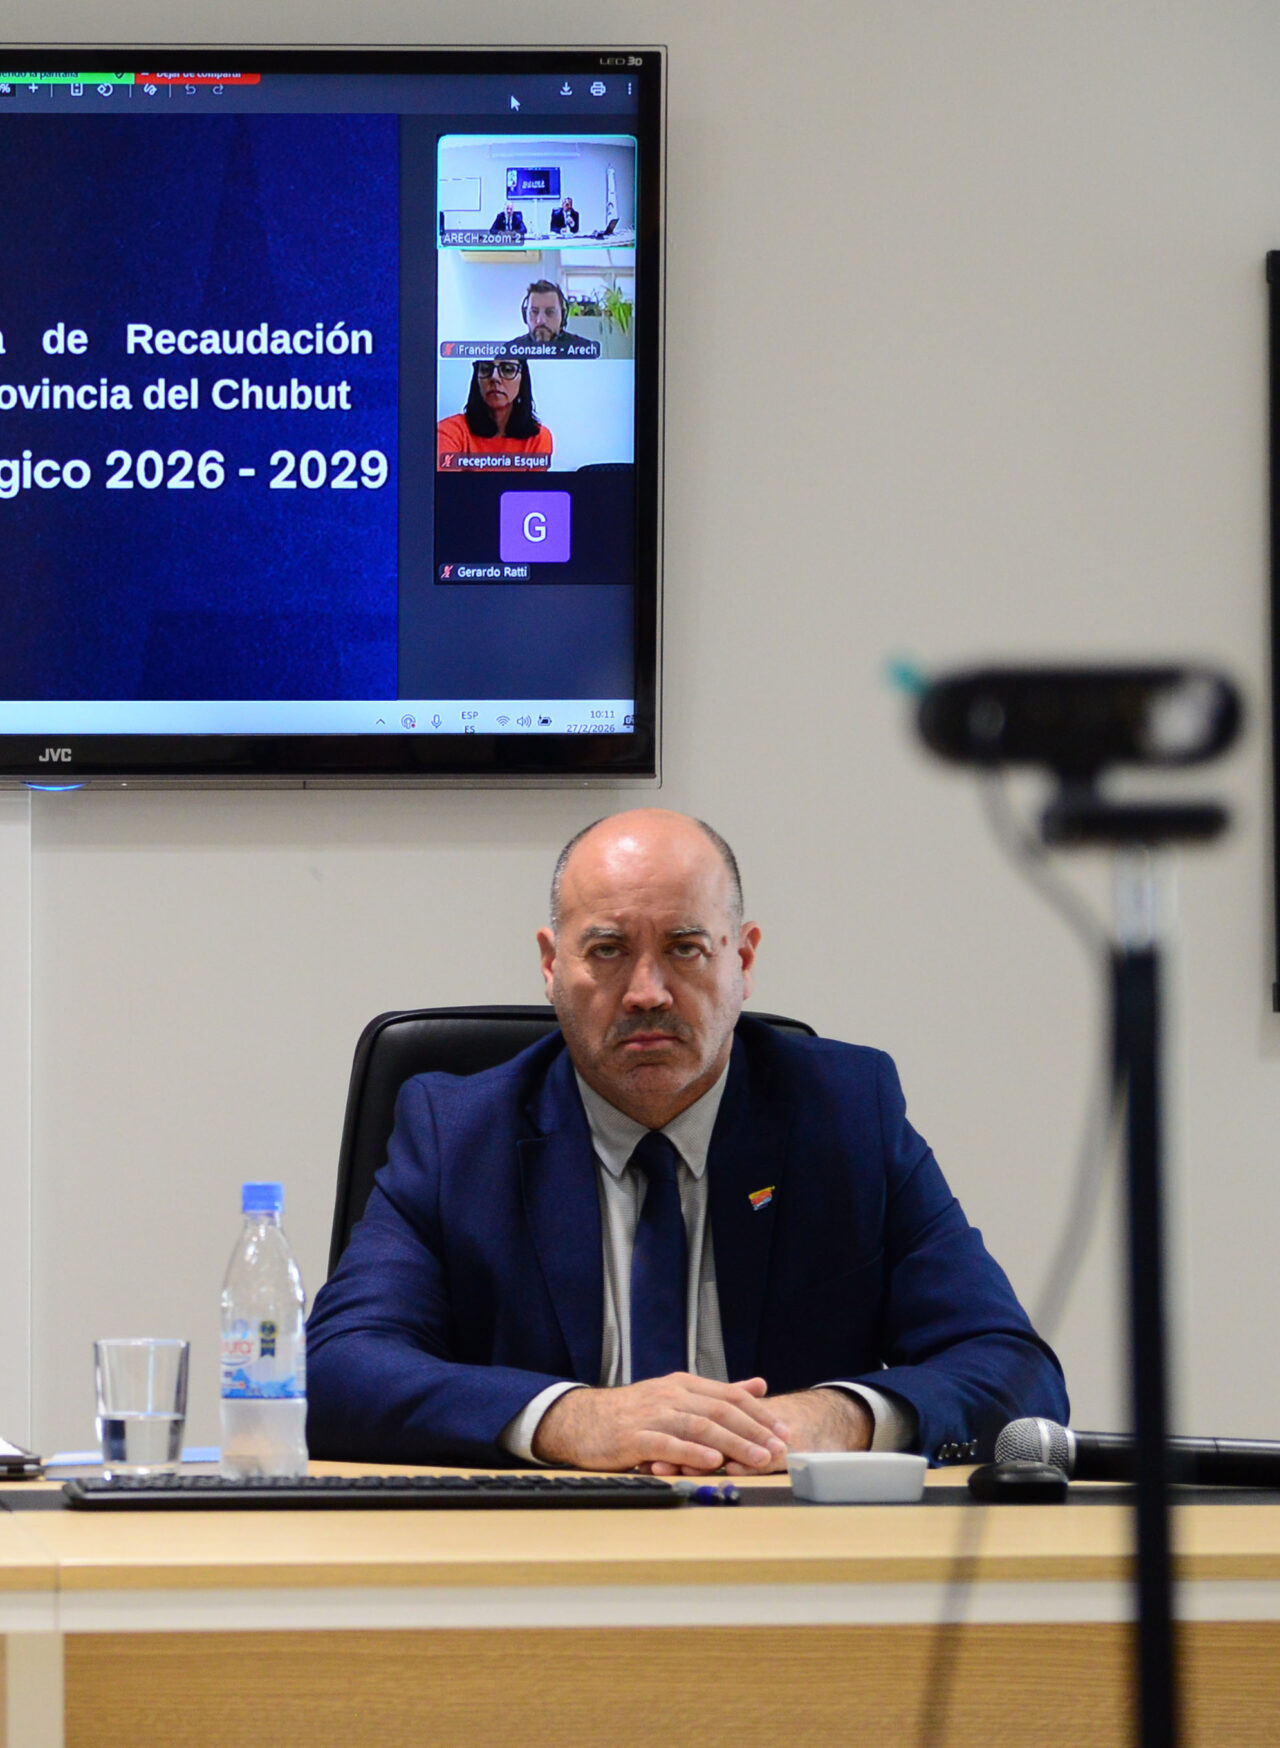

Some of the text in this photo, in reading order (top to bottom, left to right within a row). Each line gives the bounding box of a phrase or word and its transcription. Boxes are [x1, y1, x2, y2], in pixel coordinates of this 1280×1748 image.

[443, 233, 521, 243] ARECH zoom 2
[42, 322, 88, 355] de
[126, 322, 373, 355] Recaudación
[458, 344, 506, 355] Francisco
[509, 344, 557, 355] Gonzalez
[567, 344, 597, 355] Arech
[142, 377, 199, 410] del
[211, 377, 351, 410] Chubut
[458, 455, 548, 469] receptoria Esquel
[105, 450, 225, 489] 2026
[238, 468, 255, 476] -
[269, 450, 388, 489] 2029
[523, 512, 547, 542] G
[457, 566, 528, 578] Gerardo Ratti
[461, 710, 479, 720] ESP
[590, 709, 615, 719] 10:11
[464, 726, 475, 734] ES
[566, 723, 616, 733] 27/2/2026
[38, 748, 72, 762] JVC
